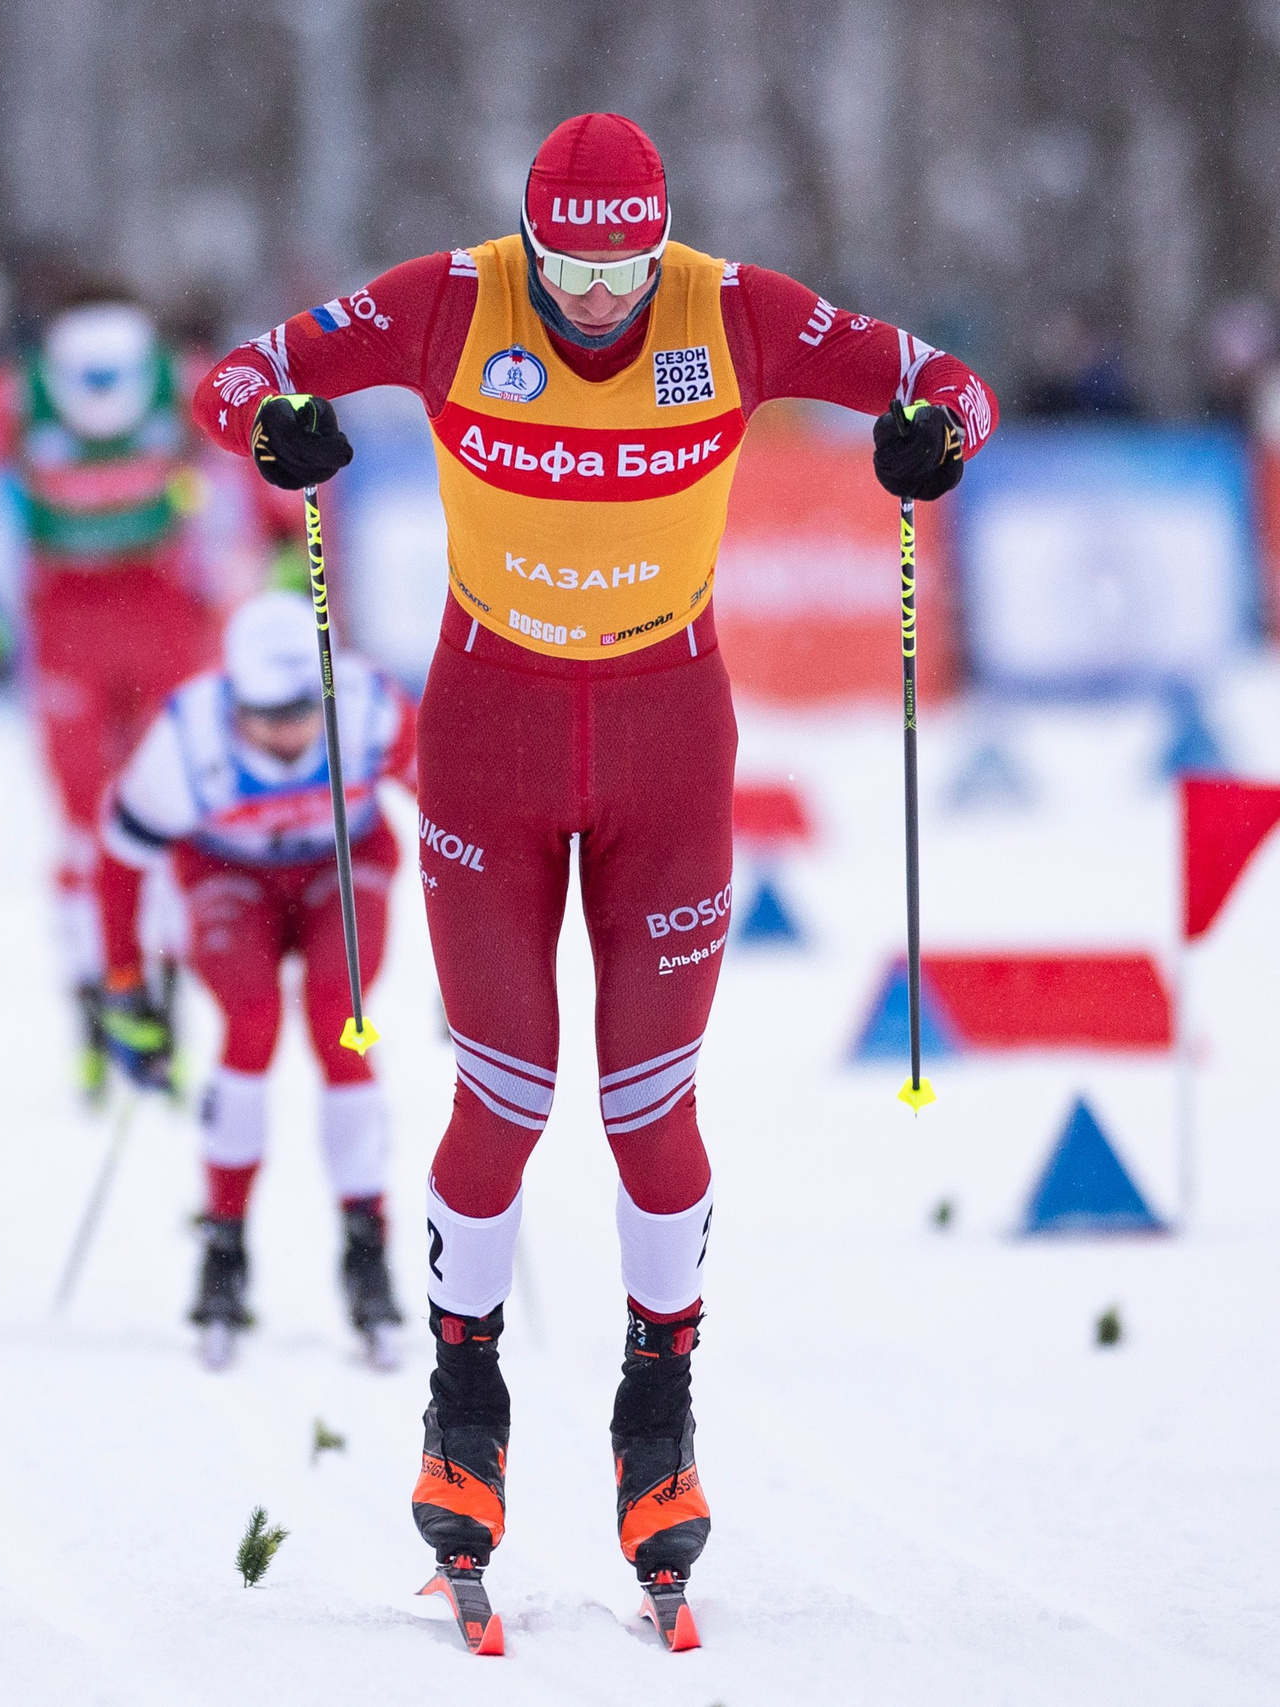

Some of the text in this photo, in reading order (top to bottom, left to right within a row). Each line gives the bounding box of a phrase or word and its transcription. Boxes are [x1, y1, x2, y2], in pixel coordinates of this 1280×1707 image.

[552, 196, 662, 225] LUKOIL
[798, 296, 838, 347] LUK
[655, 347, 706, 366] СЕЗОН
[656, 362, 709, 385] 2023
[657, 381, 713, 405] 2024
[459, 424, 723, 482] Альфа Банк
[505, 551, 660, 591] КАЗАНЬ
[509, 608, 567, 645] BOSCO
[616, 611, 673, 641] ЛУКОЙЛ
[420, 811, 484, 873] UKOIL
[646, 883, 732, 939] BOSCO
[659, 948, 709, 975] Альфа
